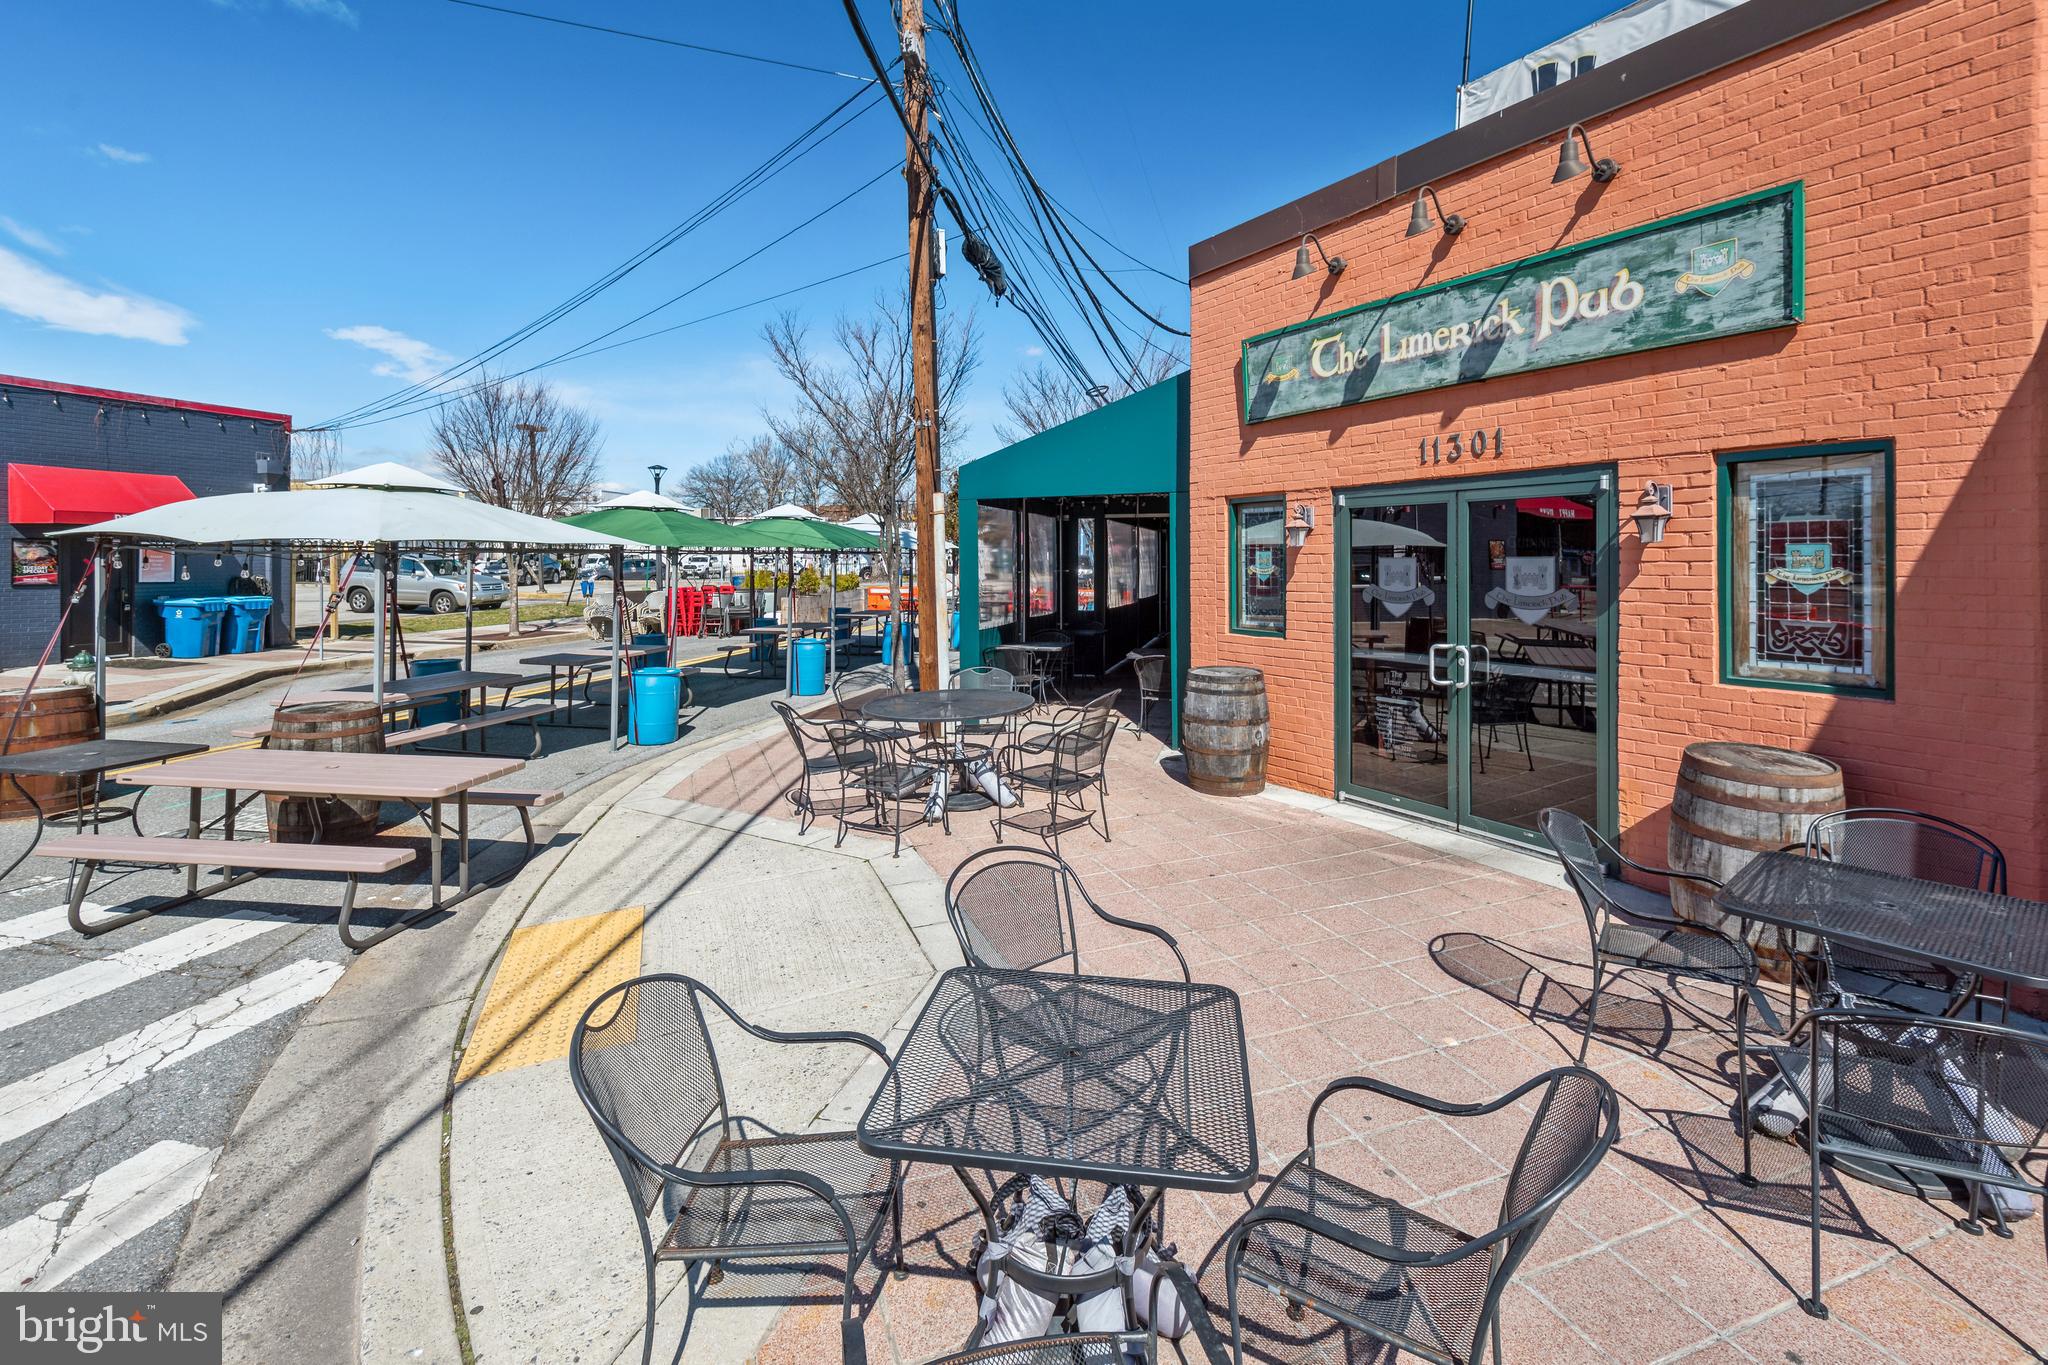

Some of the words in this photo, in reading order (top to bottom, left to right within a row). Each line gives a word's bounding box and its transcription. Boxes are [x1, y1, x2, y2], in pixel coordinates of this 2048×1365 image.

[1310, 331, 1369, 378] The
[1380, 297, 1525, 364] Limerick
[1536, 267, 1645, 344] Pub
[1418, 427, 1503, 465] 11301
[1390, 670, 1402, 678] The
[1384, 677, 1410, 688] Limerick
[1390, 686, 1403, 695] Pub
